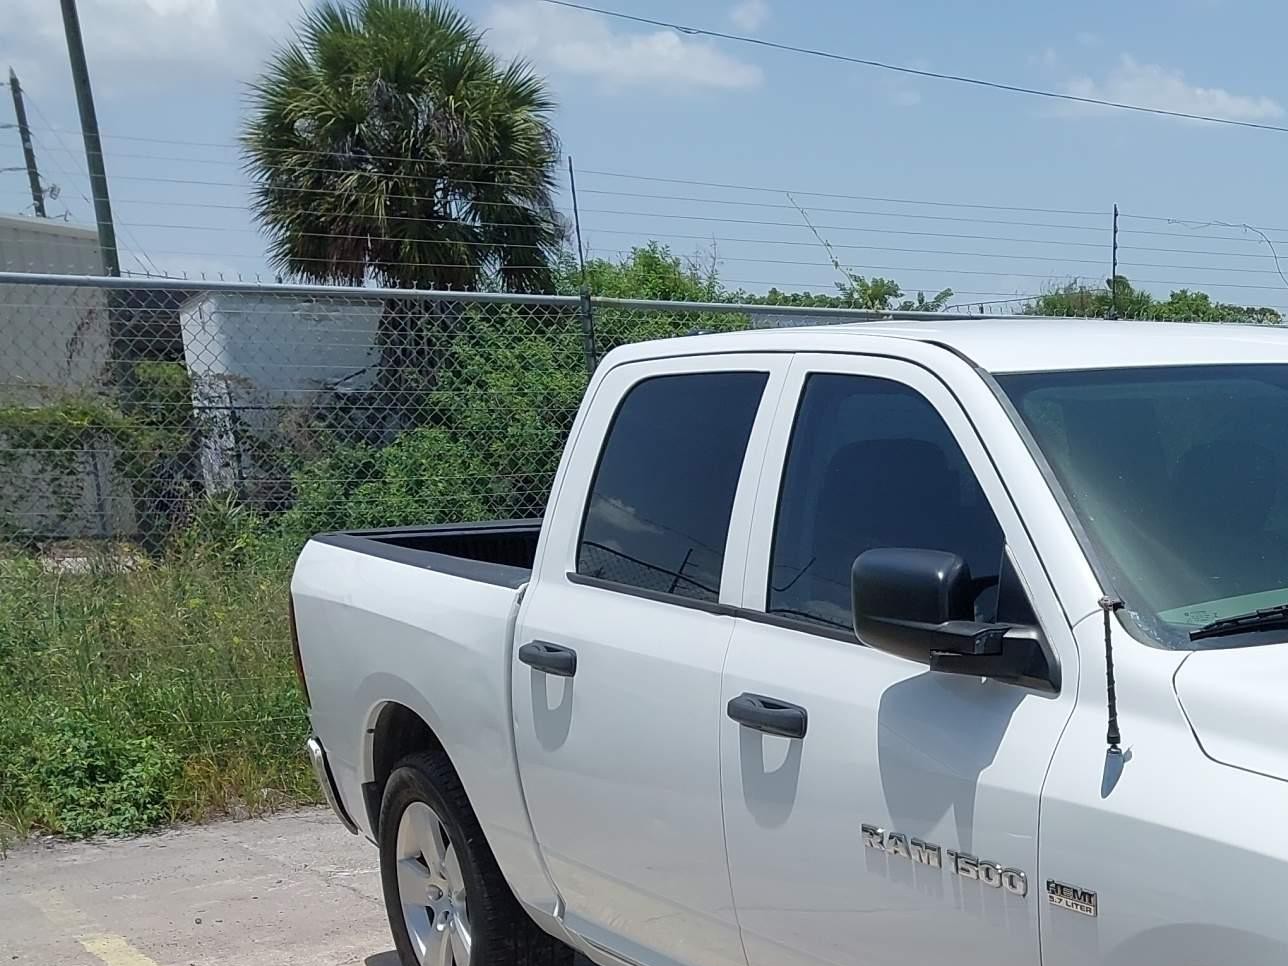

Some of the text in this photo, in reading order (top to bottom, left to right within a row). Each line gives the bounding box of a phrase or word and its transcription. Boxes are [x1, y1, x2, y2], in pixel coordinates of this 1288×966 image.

[861, 823, 1028, 898] RAM 1500
[1047, 879, 1096, 906] HEMI
[1048, 894, 1093, 914] 5.7 LITER
